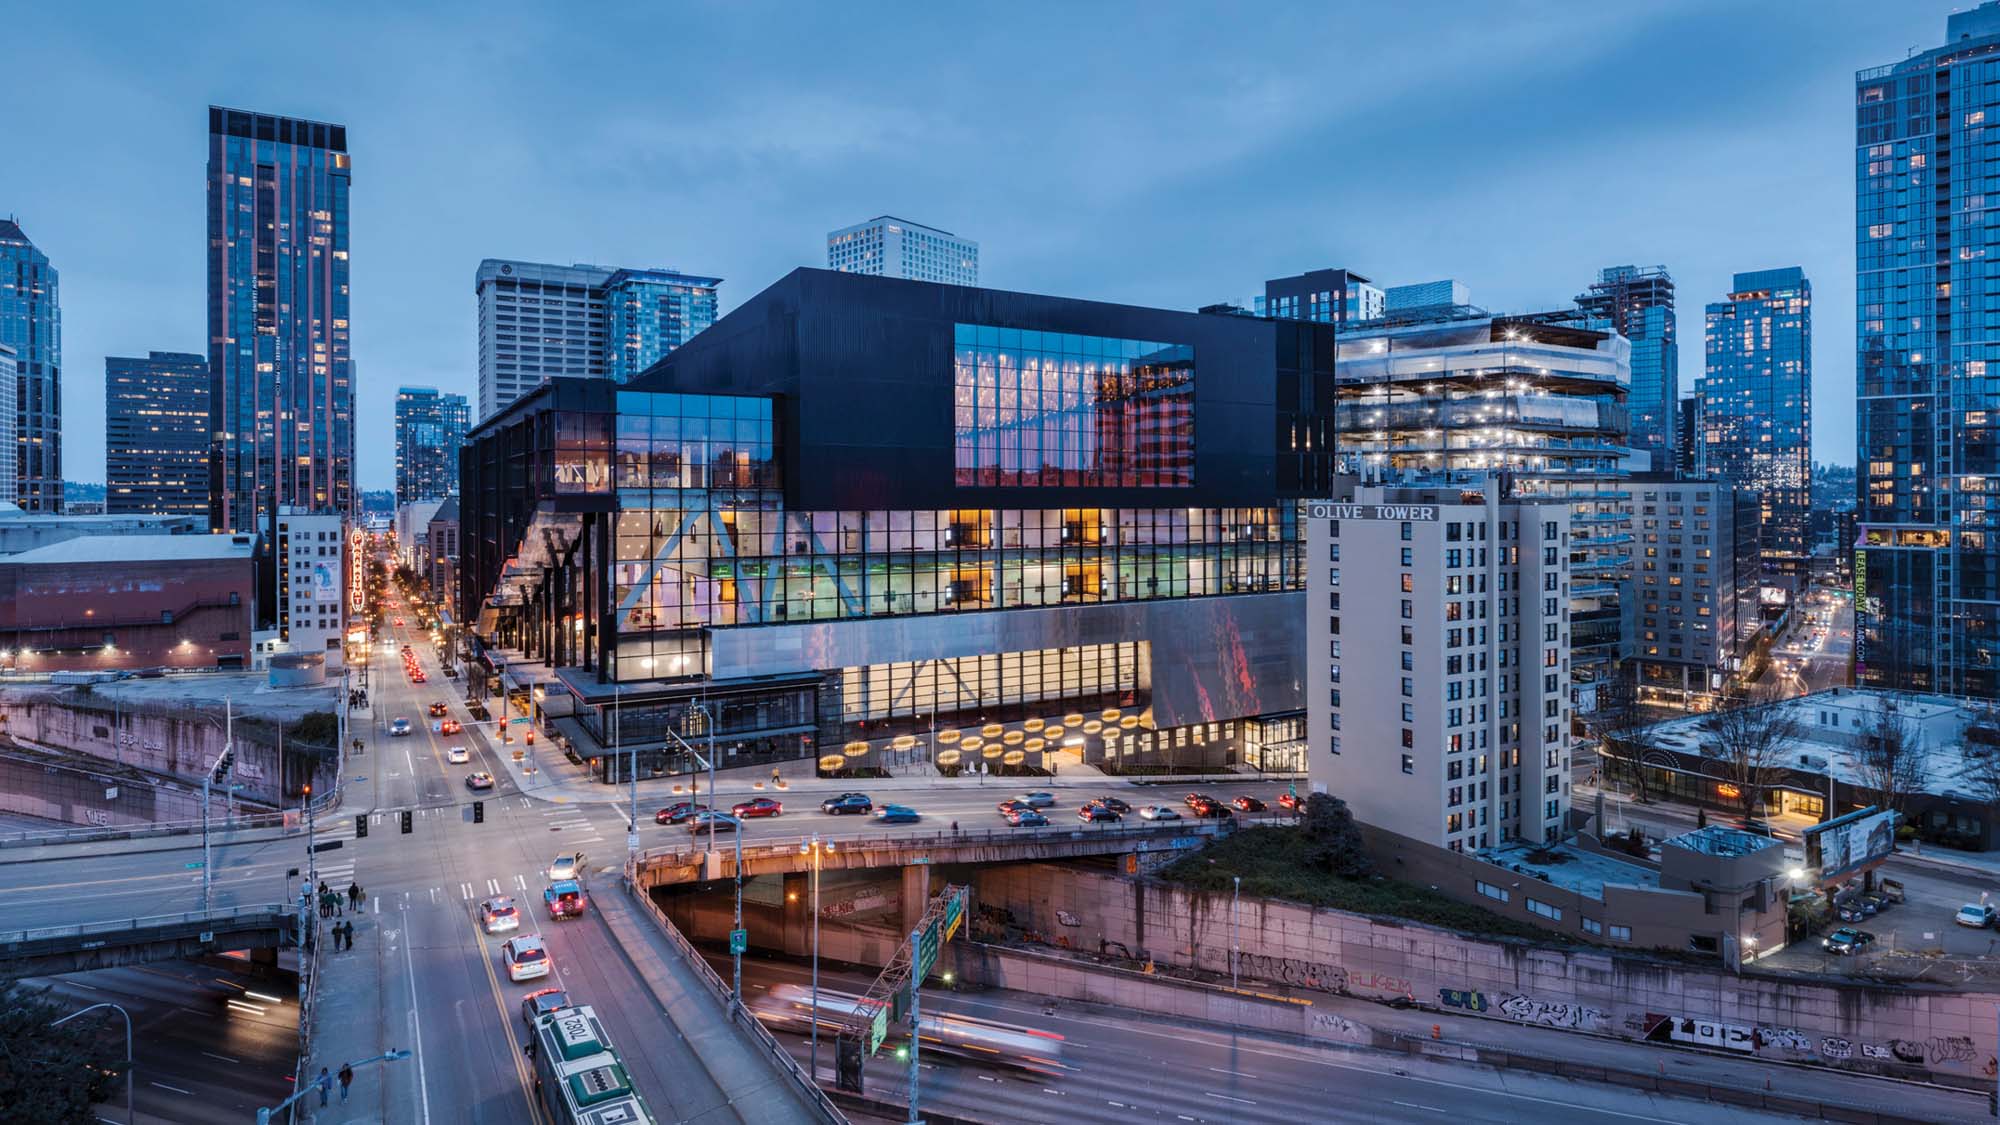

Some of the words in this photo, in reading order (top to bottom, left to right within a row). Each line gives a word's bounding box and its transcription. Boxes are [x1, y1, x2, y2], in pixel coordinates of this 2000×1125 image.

[1313, 505, 1363, 519] OLIVE
[1375, 506, 1433, 520] TOWER
[1856, 552, 1865, 579] LEASE
[1856, 581, 1865, 610] TODAY
[564, 1018, 588, 1040] 7082
